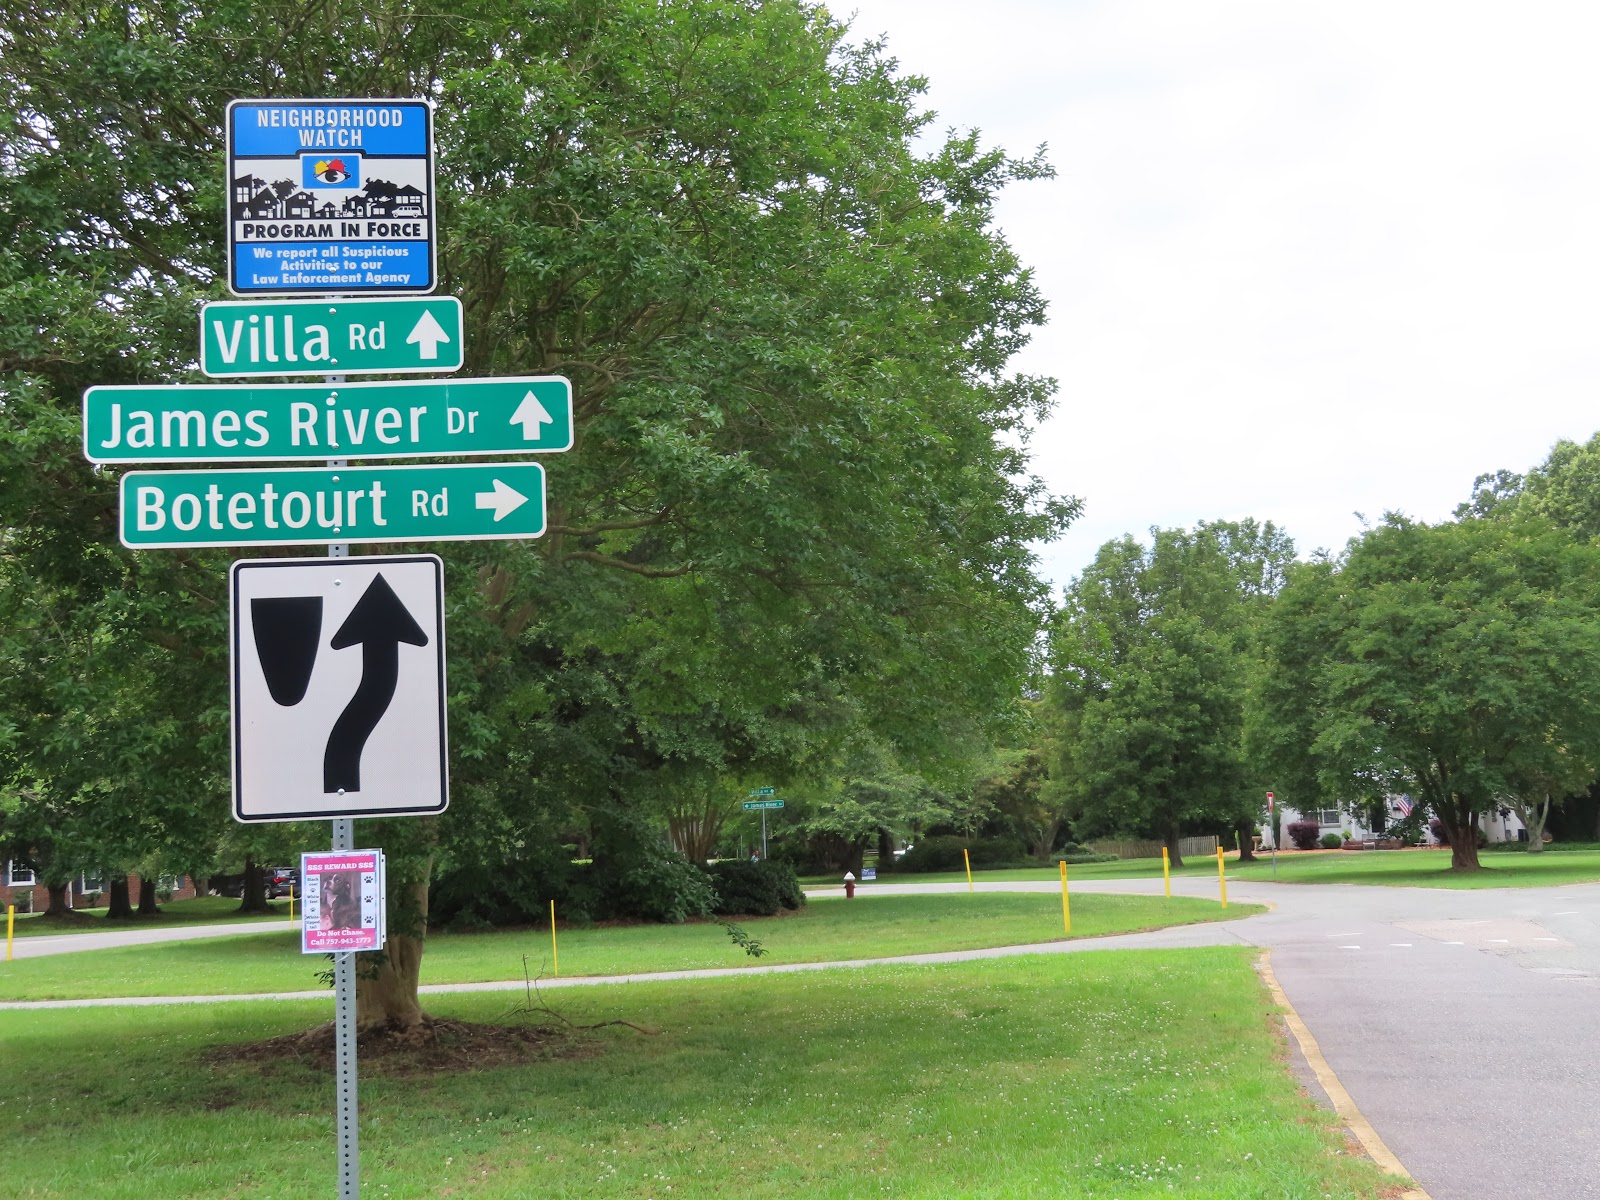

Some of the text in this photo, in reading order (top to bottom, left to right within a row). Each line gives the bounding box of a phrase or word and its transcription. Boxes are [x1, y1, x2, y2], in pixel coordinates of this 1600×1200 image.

[257, 109, 403, 127] NEIGHBORHOOD
[298, 129, 362, 147] WATCH
[243, 222, 421, 239] PROGRAM IN FORCE
[253, 245, 409, 260] We report all Suspicious
[280, 259, 383, 271] Activities to our
[253, 272, 411, 285] Law Enforcement Agency
[213, 314, 386, 364] Villa Rd
[101, 397, 479, 450] James River Dr
[137, 481, 449, 531] Botetourt Rd
